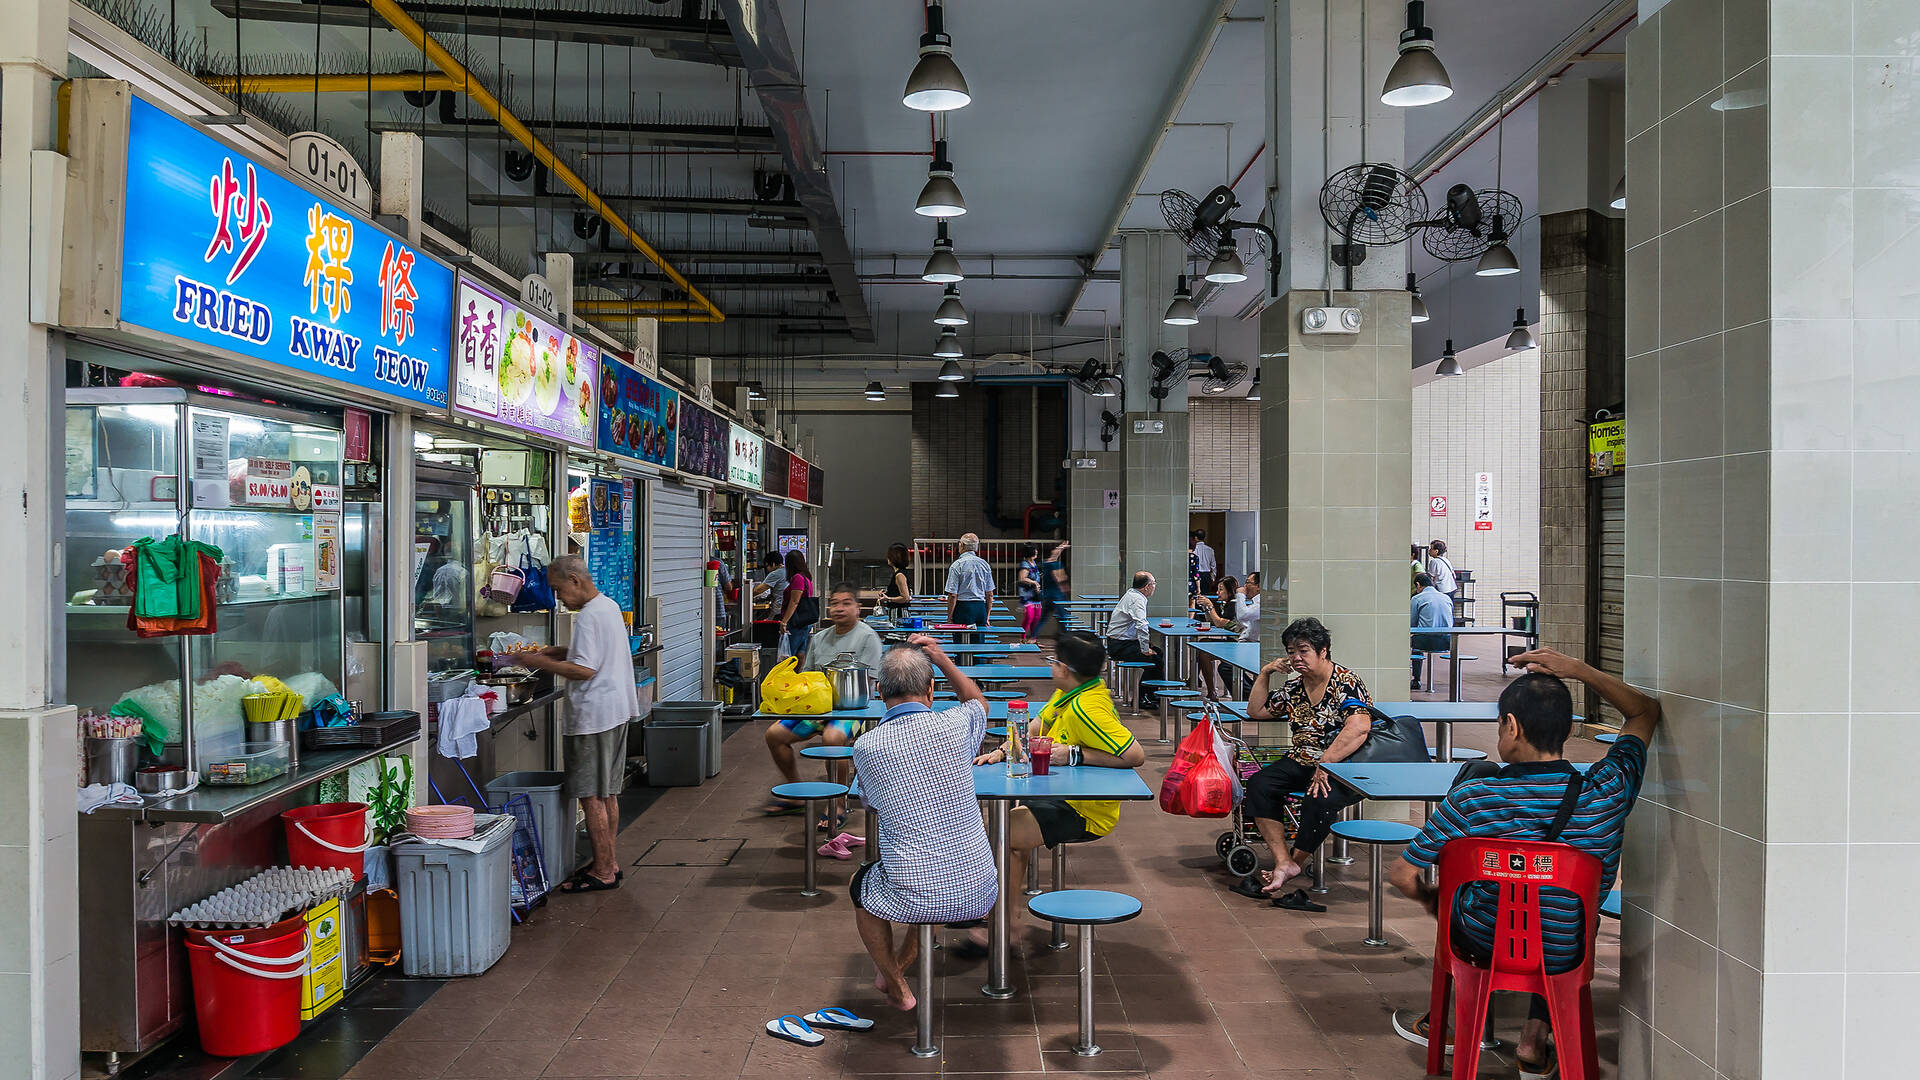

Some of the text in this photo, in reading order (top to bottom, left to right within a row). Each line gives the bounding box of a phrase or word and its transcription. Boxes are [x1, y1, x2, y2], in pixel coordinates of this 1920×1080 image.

[307, 142, 358, 199] 01-01
[528, 279, 553, 313] 01-02
[174, 276, 429, 391] FRIED KWAY TEOW
[460, 299, 498, 377] 香香
[1591, 425, 1620, 440] Homes
[249, 482, 288, 498] $3.00/$4.00
